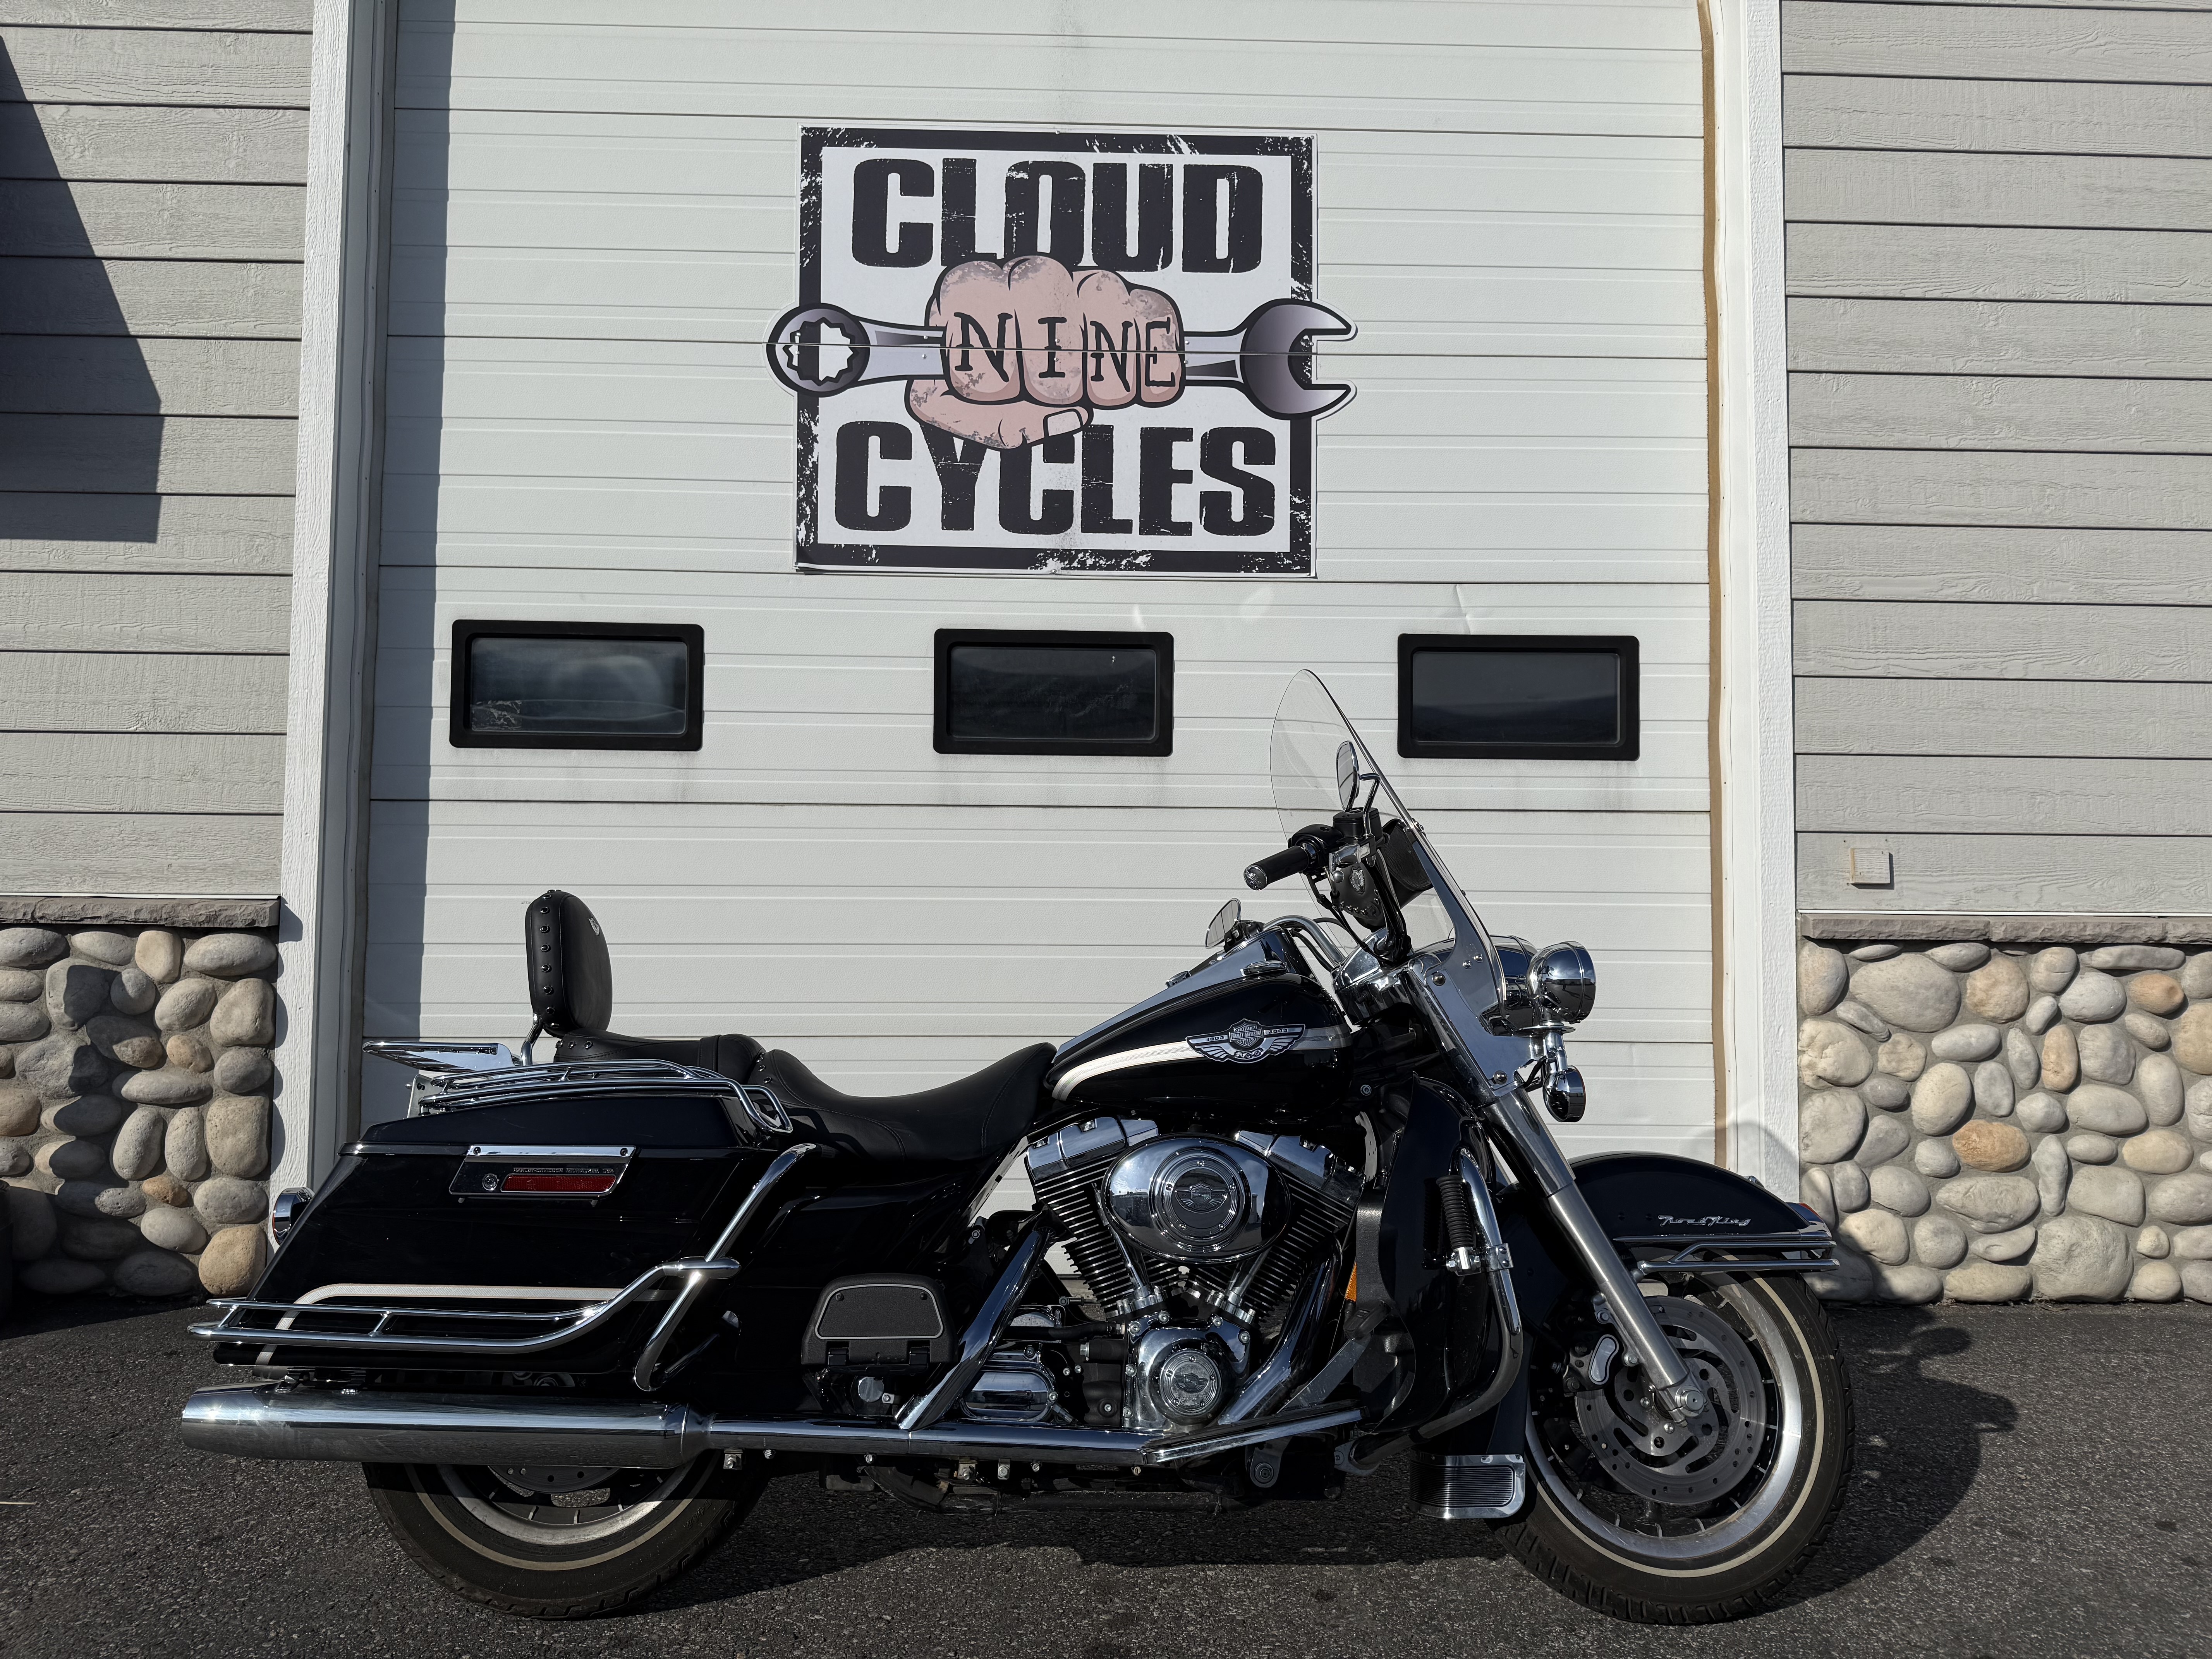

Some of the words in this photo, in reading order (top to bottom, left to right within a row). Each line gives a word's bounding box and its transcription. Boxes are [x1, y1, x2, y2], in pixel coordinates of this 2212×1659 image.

[852, 158, 1263, 273] CLOUD
[953, 311, 1176, 392] NINE
[835, 421, 1276, 536] CYCLES
